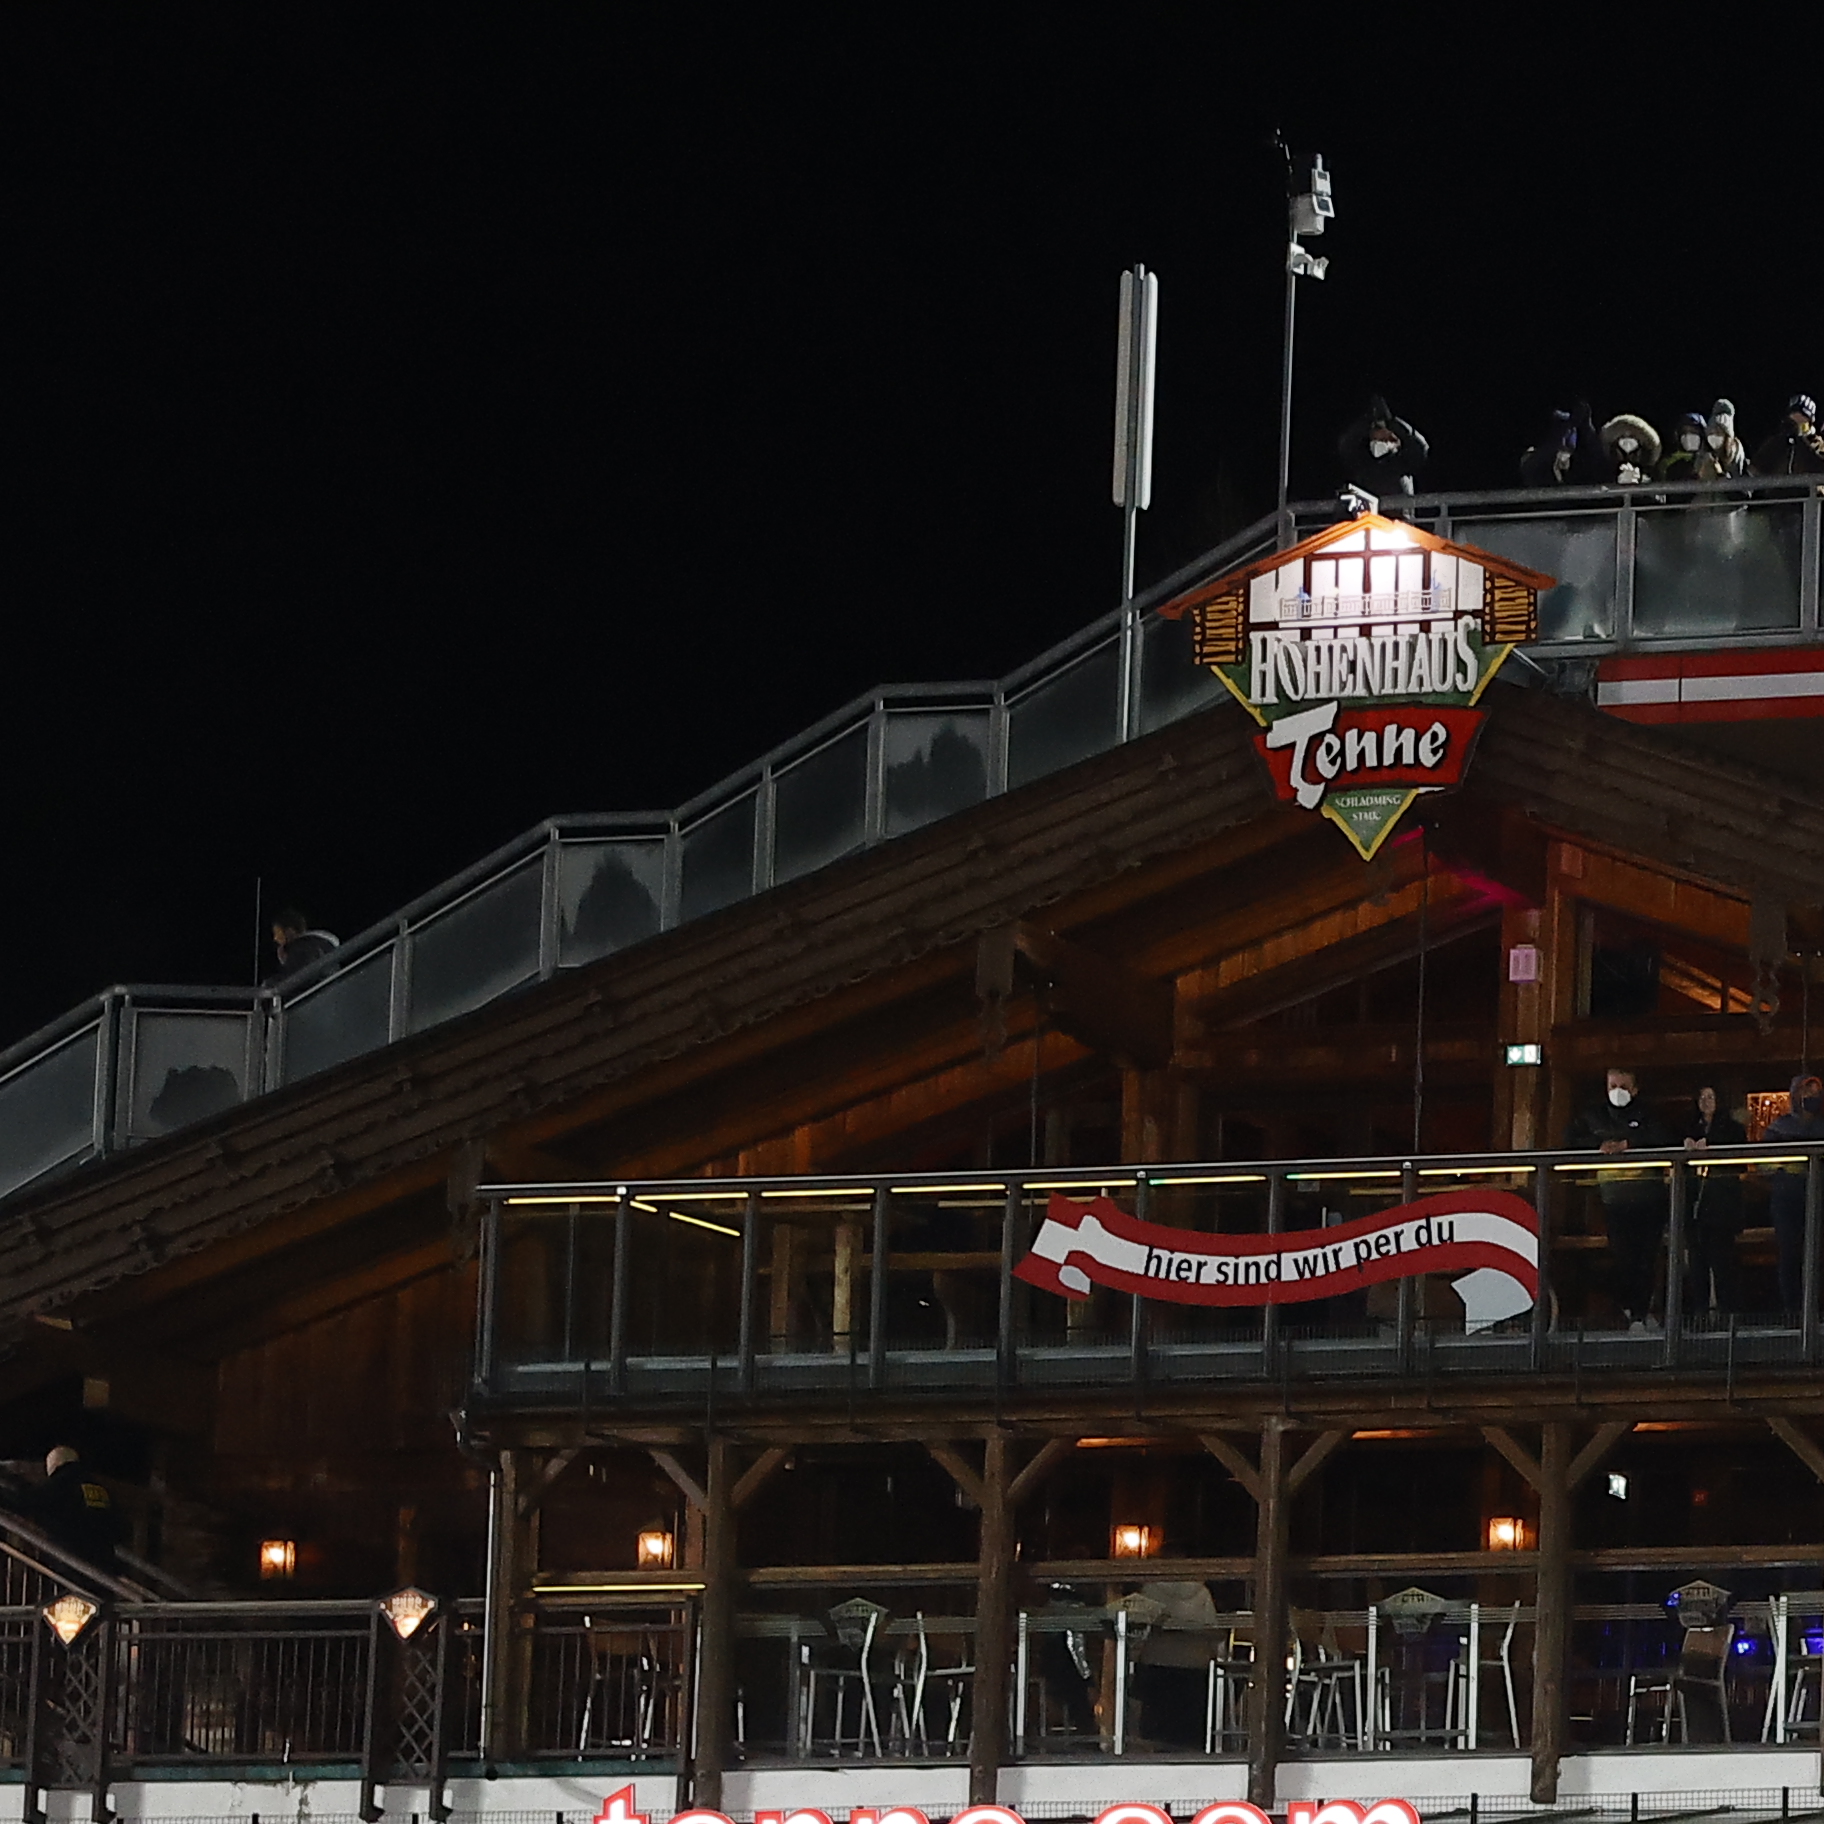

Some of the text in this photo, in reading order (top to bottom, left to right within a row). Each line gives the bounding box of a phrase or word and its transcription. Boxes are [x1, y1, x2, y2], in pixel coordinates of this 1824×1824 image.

[1251, 614, 1481, 705] HOHENHAUS
[1267, 702, 1447, 809] Tenne
[1145, 1214, 1455, 1287] hier sind wir per du
